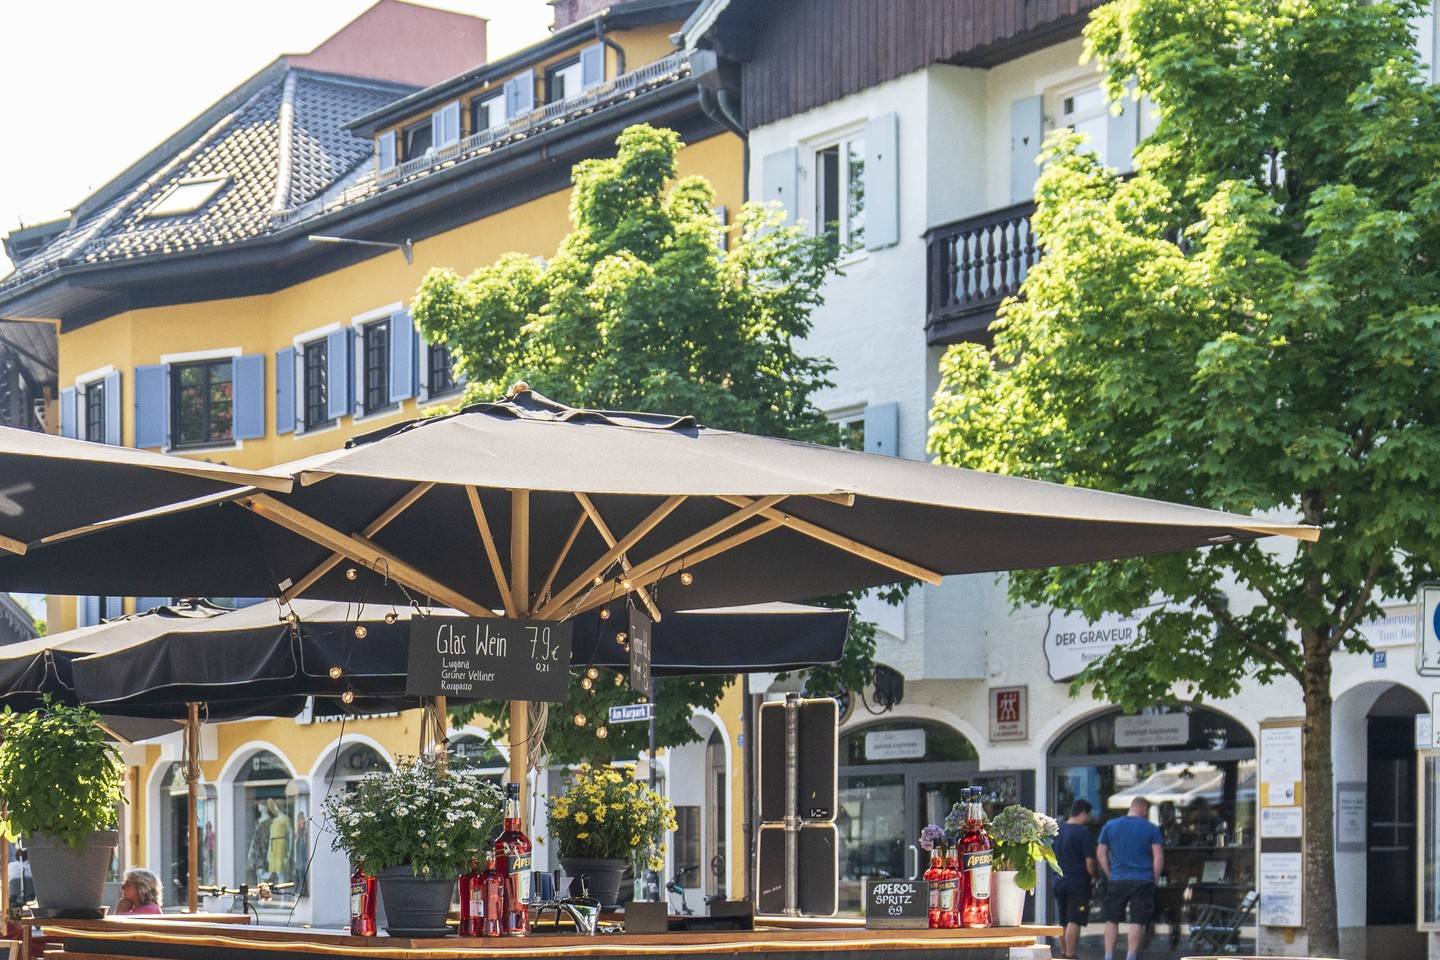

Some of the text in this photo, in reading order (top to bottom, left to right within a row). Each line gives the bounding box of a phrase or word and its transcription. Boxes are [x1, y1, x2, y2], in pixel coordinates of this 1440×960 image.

[436, 624, 466, 655] Glas
[475, 624, 507, 657] Wein
[1055, 627, 1133, 647] DER GRAVEUR
[442, 657, 470, 672] Lugana
[612, 708, 622, 719] Am
[512, 856, 532, 870] APE
[967, 853, 993, 867] APERO
[873, 883, 917, 895] APEROL
[875, 895, 913, 905] SPRITZ
